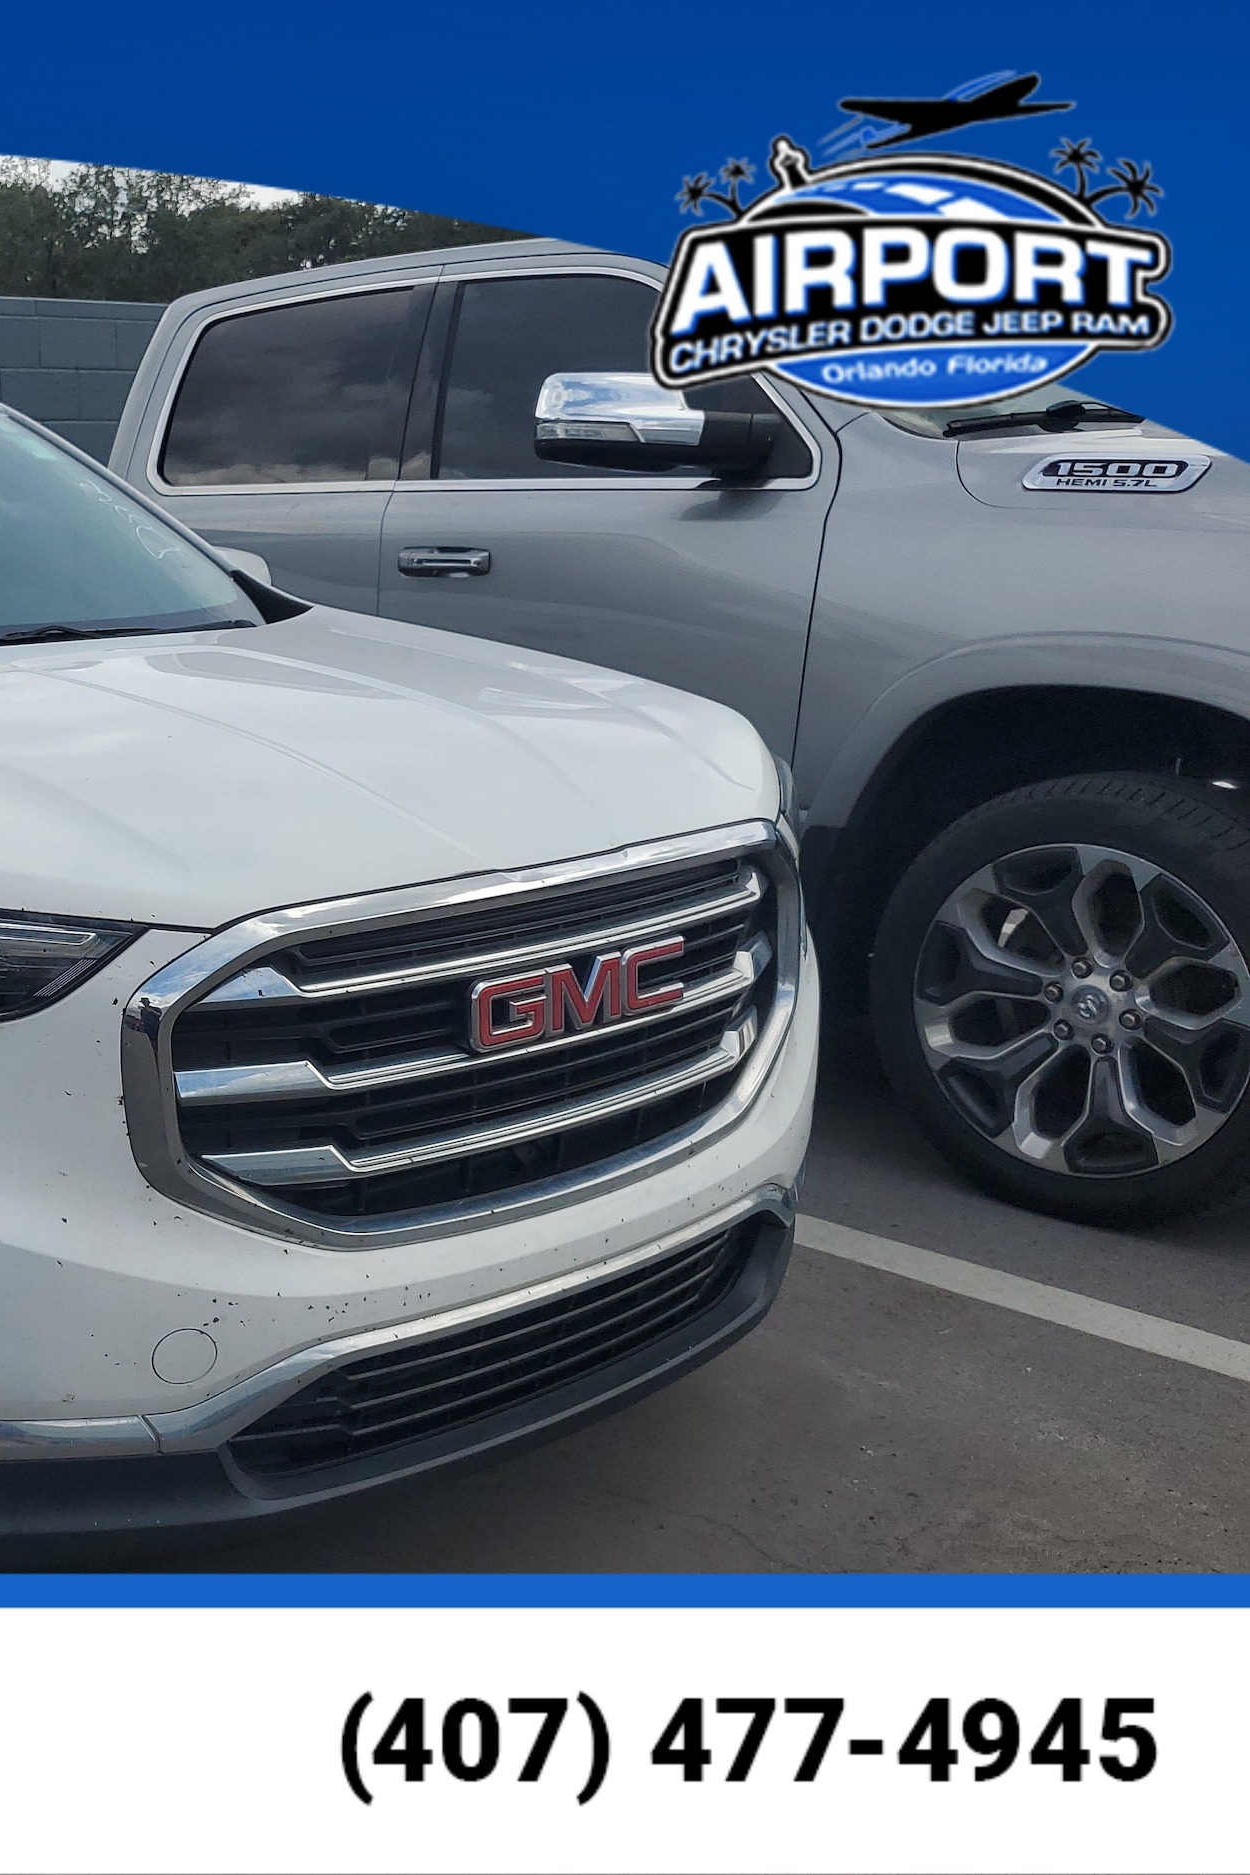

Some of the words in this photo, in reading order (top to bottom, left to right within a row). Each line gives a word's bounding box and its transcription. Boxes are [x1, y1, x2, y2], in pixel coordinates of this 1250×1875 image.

[1056, 461, 1178, 477] 1500
[1056, 478, 1107, 487] HEMI
[1113, 479, 1158, 487] 5.7L
[470, 935, 684, 1053] GMC
